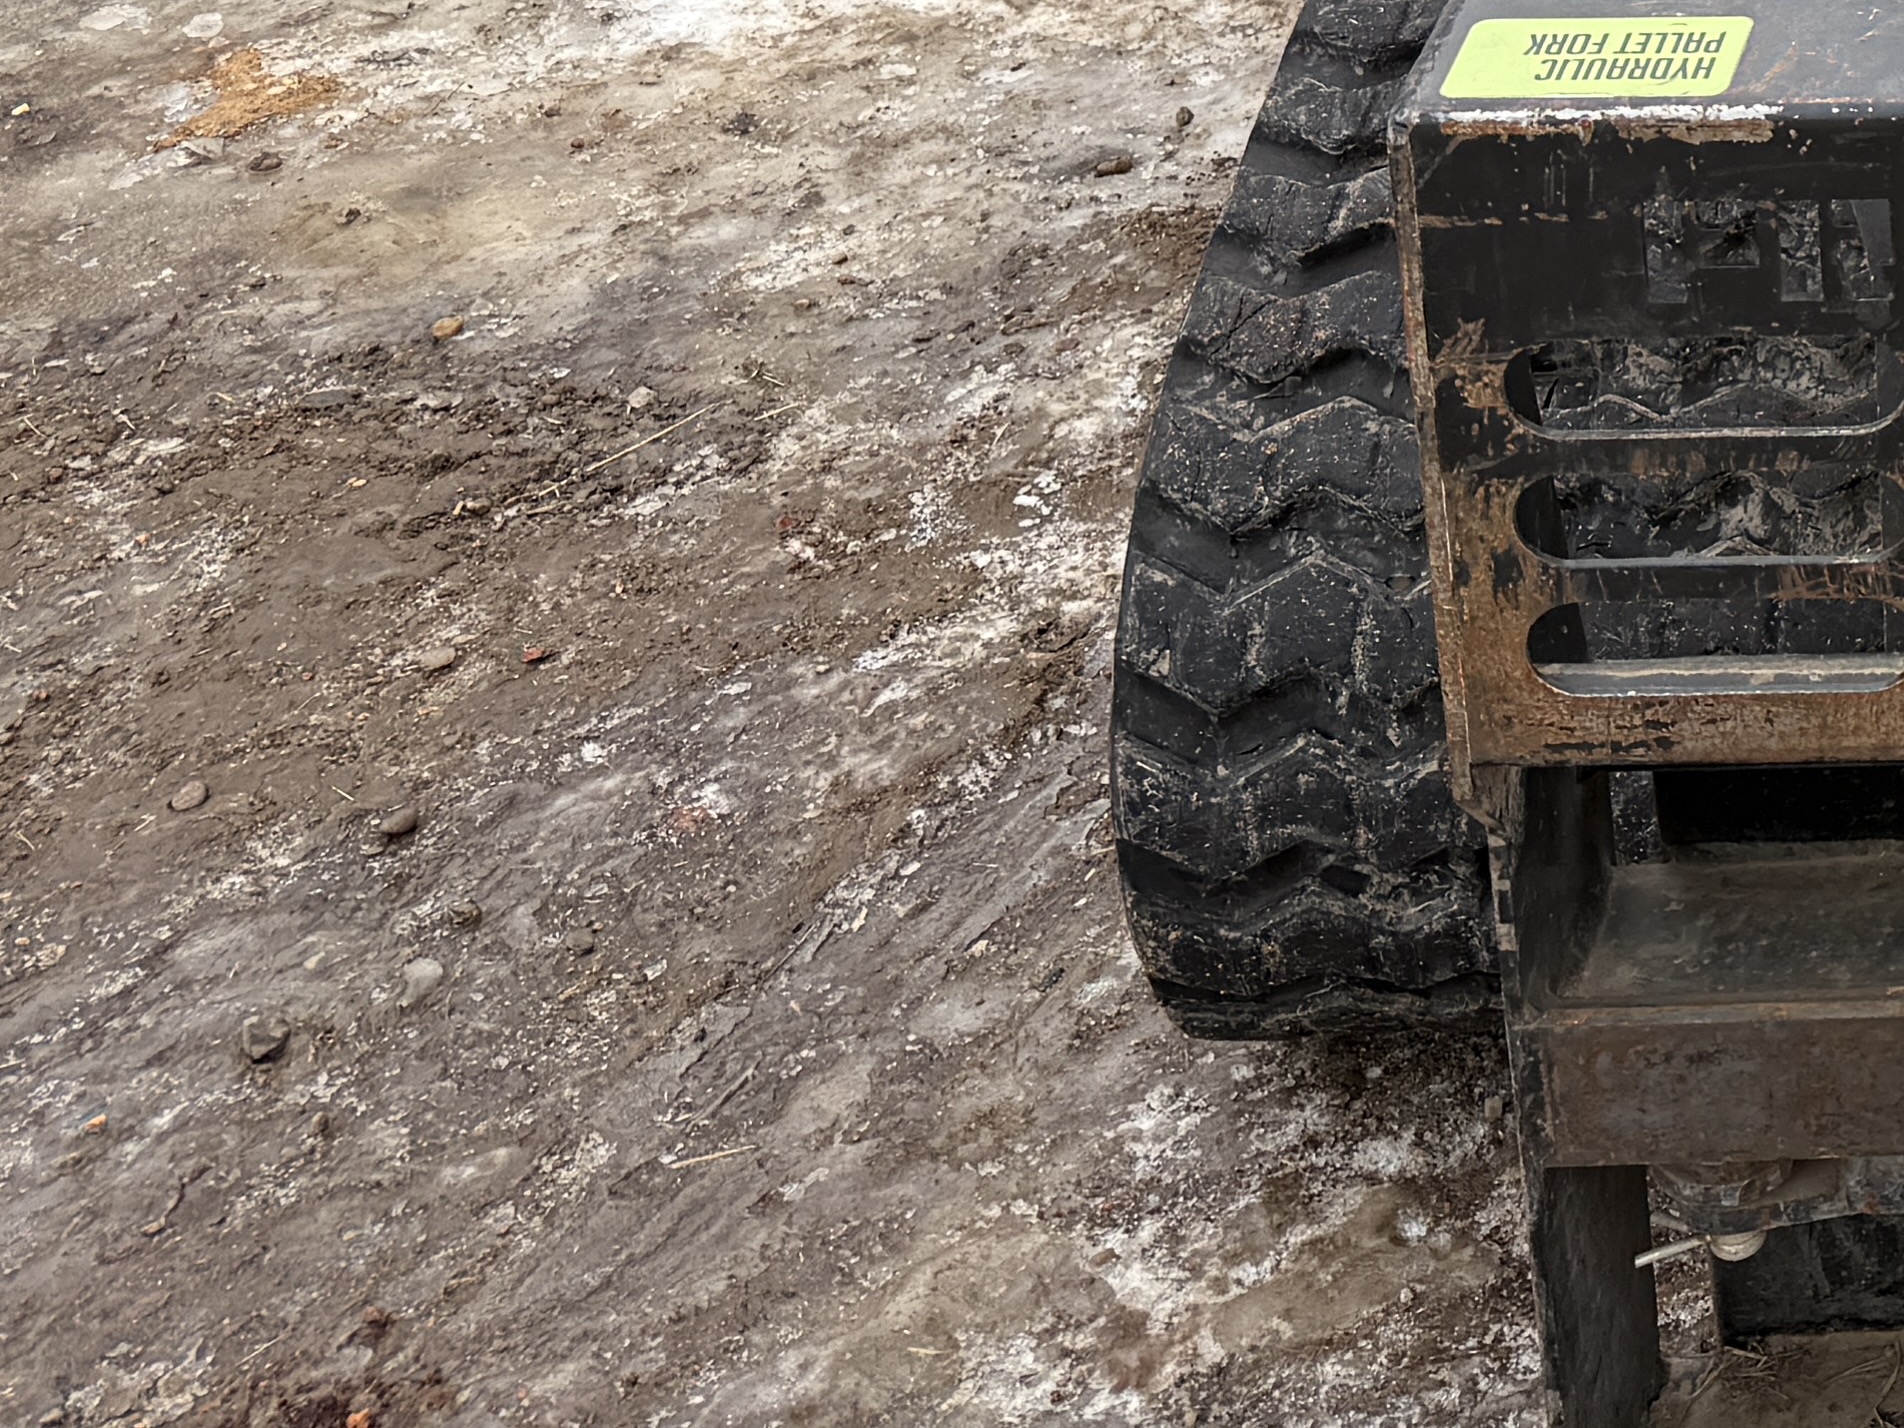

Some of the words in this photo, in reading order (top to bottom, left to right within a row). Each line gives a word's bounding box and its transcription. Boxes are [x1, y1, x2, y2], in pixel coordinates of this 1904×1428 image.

[1523, 33, 1610, 55] FORK
[1613, 31, 1726, 54] PALLET
[1534, 57, 1717, 81] HYDRAULIC
